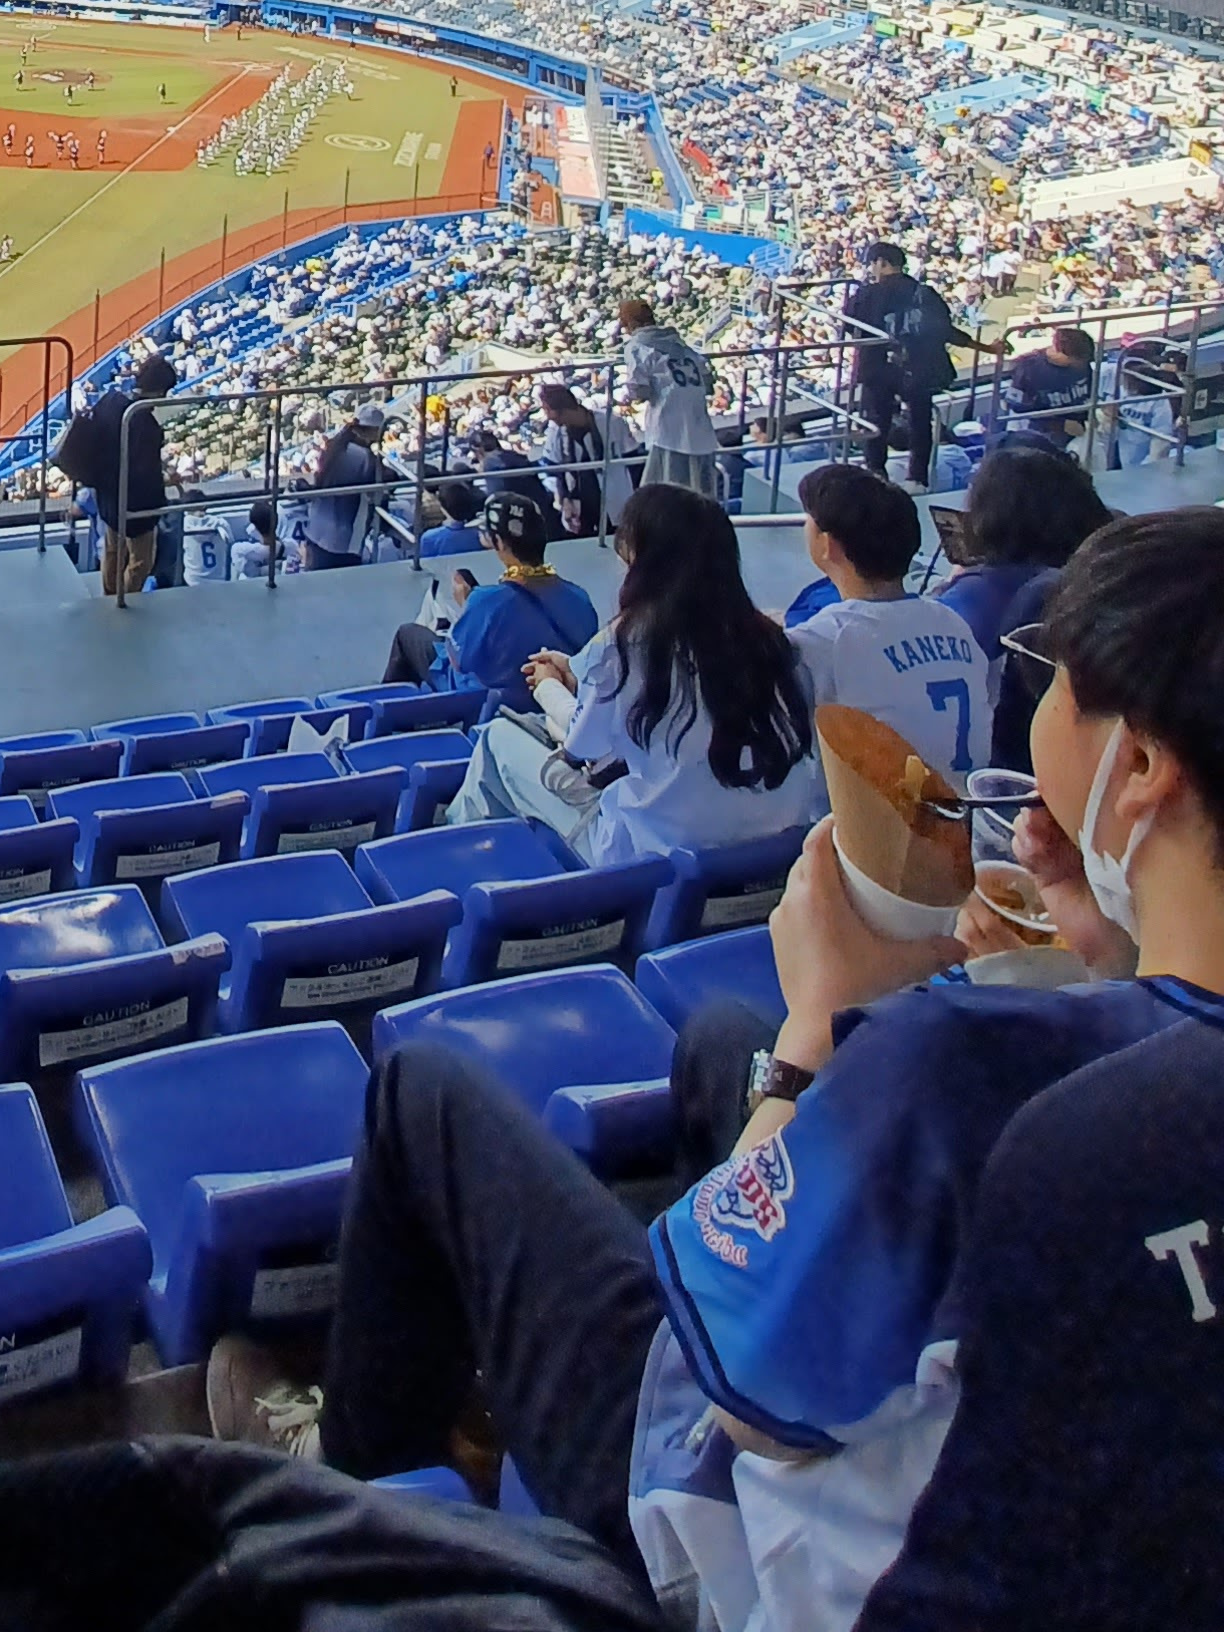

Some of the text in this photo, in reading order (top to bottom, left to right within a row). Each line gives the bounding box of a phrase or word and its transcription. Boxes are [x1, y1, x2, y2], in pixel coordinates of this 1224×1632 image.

[667, 357, 700, 387] 63
[201, 541, 216, 568] 6
[883, 634, 972, 673] KANEKO
[926, 678, 973, 771] 7
[327, 956, 389, 974] CAUTION
[83, 1000, 150, 1025] CAUTION
[1144, 1219, 1224, 1322] T
